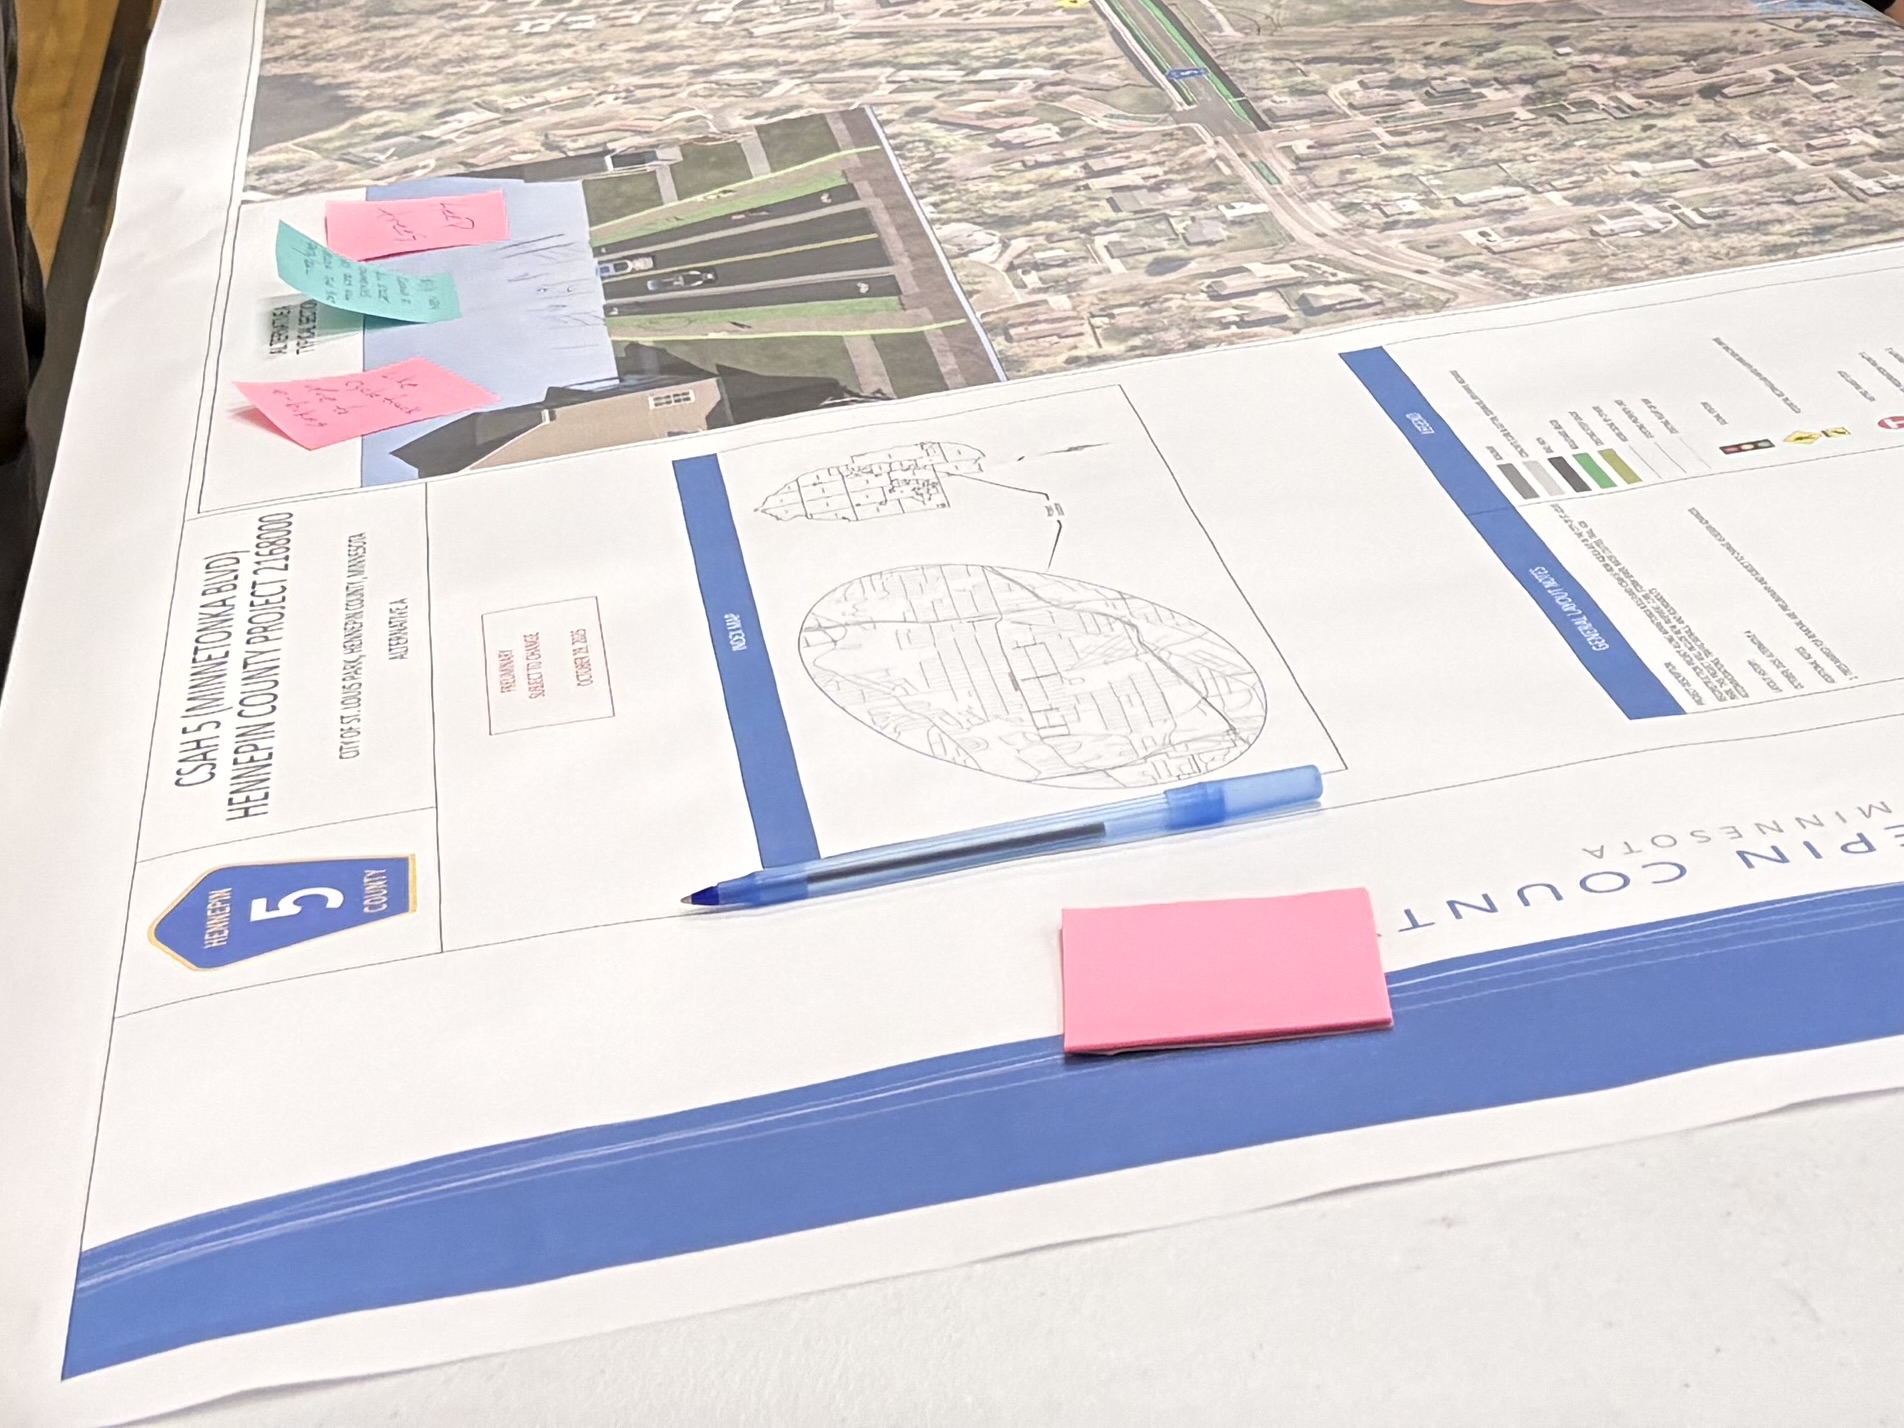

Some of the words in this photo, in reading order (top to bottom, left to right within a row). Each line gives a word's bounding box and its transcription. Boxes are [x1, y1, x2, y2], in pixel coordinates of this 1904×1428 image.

[252, 511, 294, 576] 2168000
[201, 550, 250, 597] BLVD)
[246, 579, 288, 645] PROJECT
[180, 595, 237, 719] (MINNETONKA
[237, 648, 282, 718] COUNTY
[341, 682, 363, 710] LOUIS
[181, 720, 222, 734] 5
[339, 740, 360, 760] CITY
[340, 726, 361, 739] OF
[174, 735, 220, 787] CSAH
[225, 721, 276, 821] HENNEPIN
[1581, 799, 1895, 860] MINNESOTA
[202, 887, 233, 949] HENNEPIN
[250, 886, 345, 923] 5
[362, 869, 387, 914] COUNTY
[1377, 860, 1689, 939] COUNT
